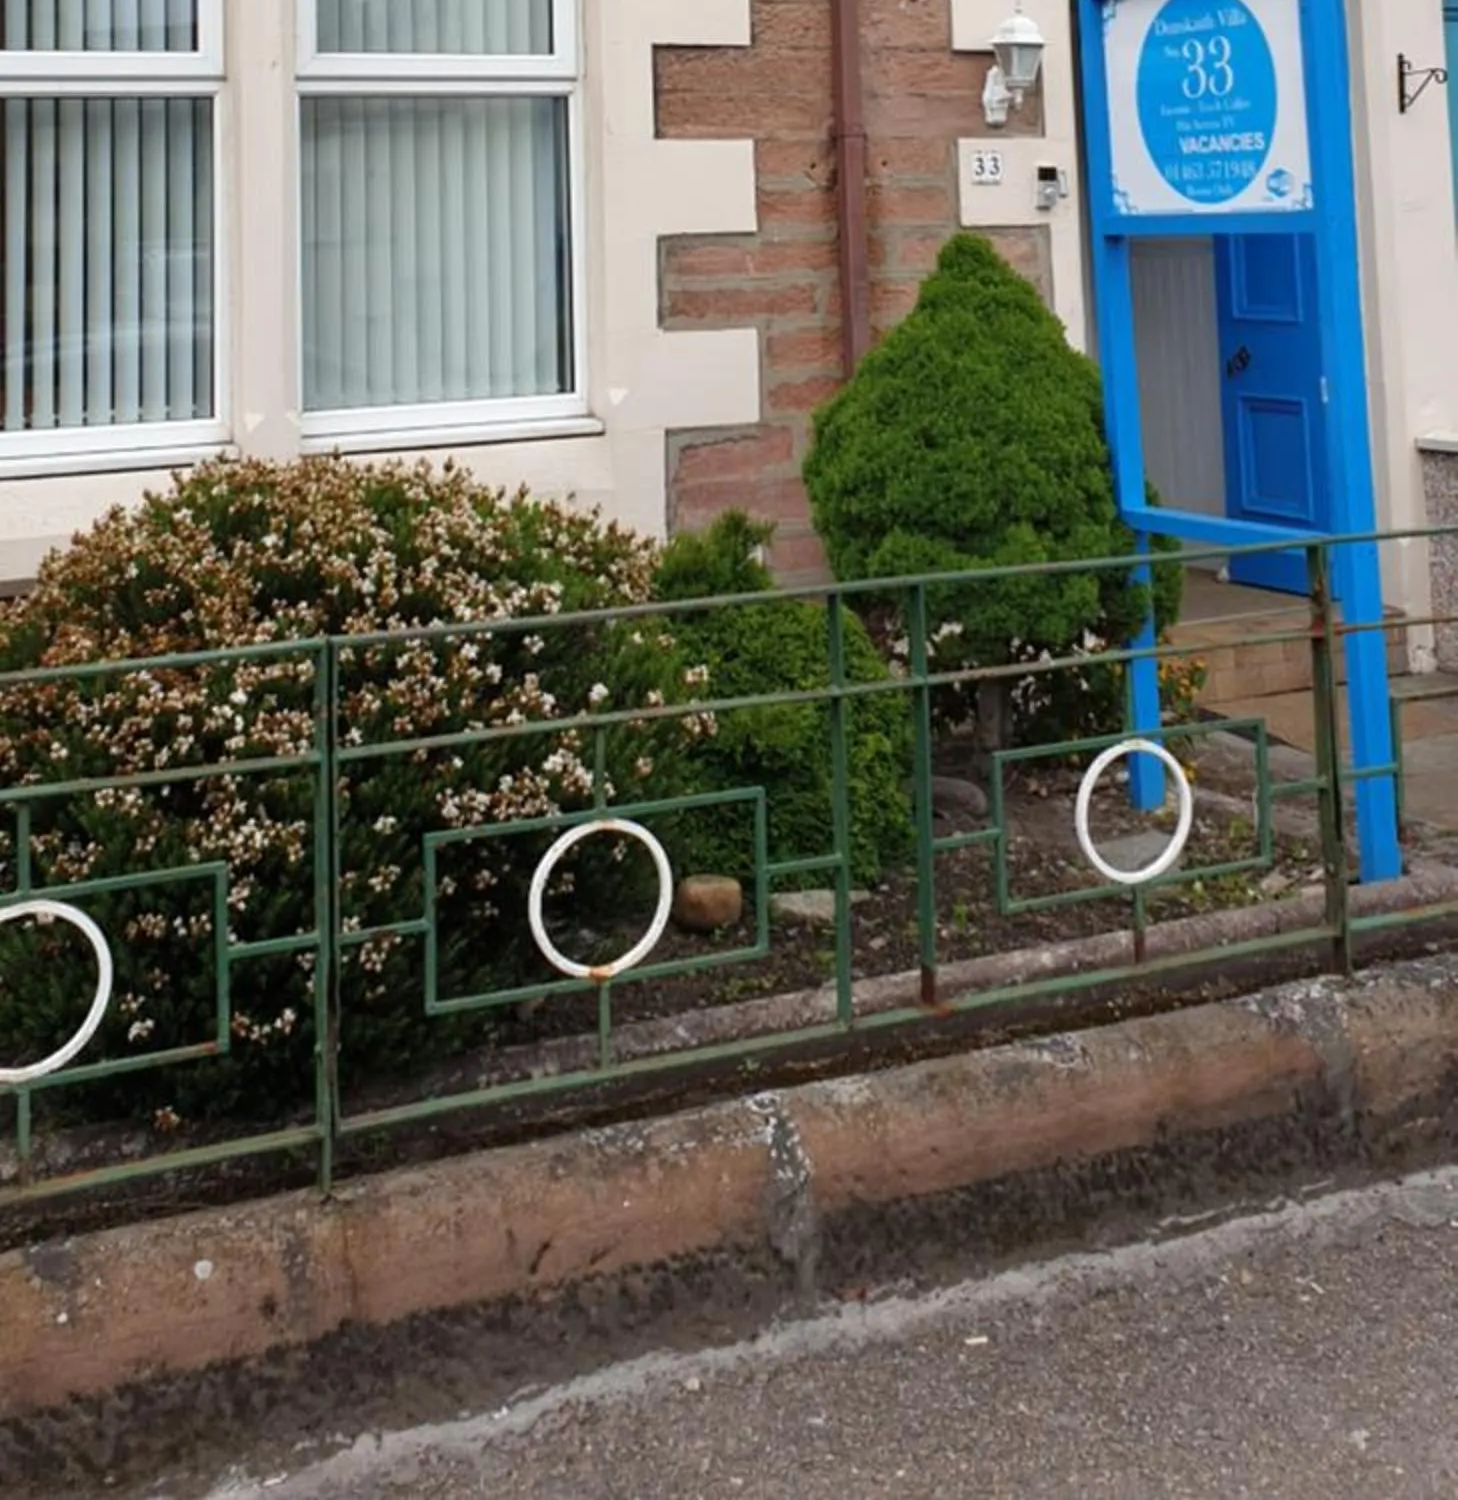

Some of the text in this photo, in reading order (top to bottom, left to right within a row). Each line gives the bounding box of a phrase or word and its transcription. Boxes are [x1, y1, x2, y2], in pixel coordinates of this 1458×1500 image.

[1182, 35, 1233, 98] 33
[1179, 132, 1265, 153] VACANCIES
[975, 156, 1000, 177] 33
